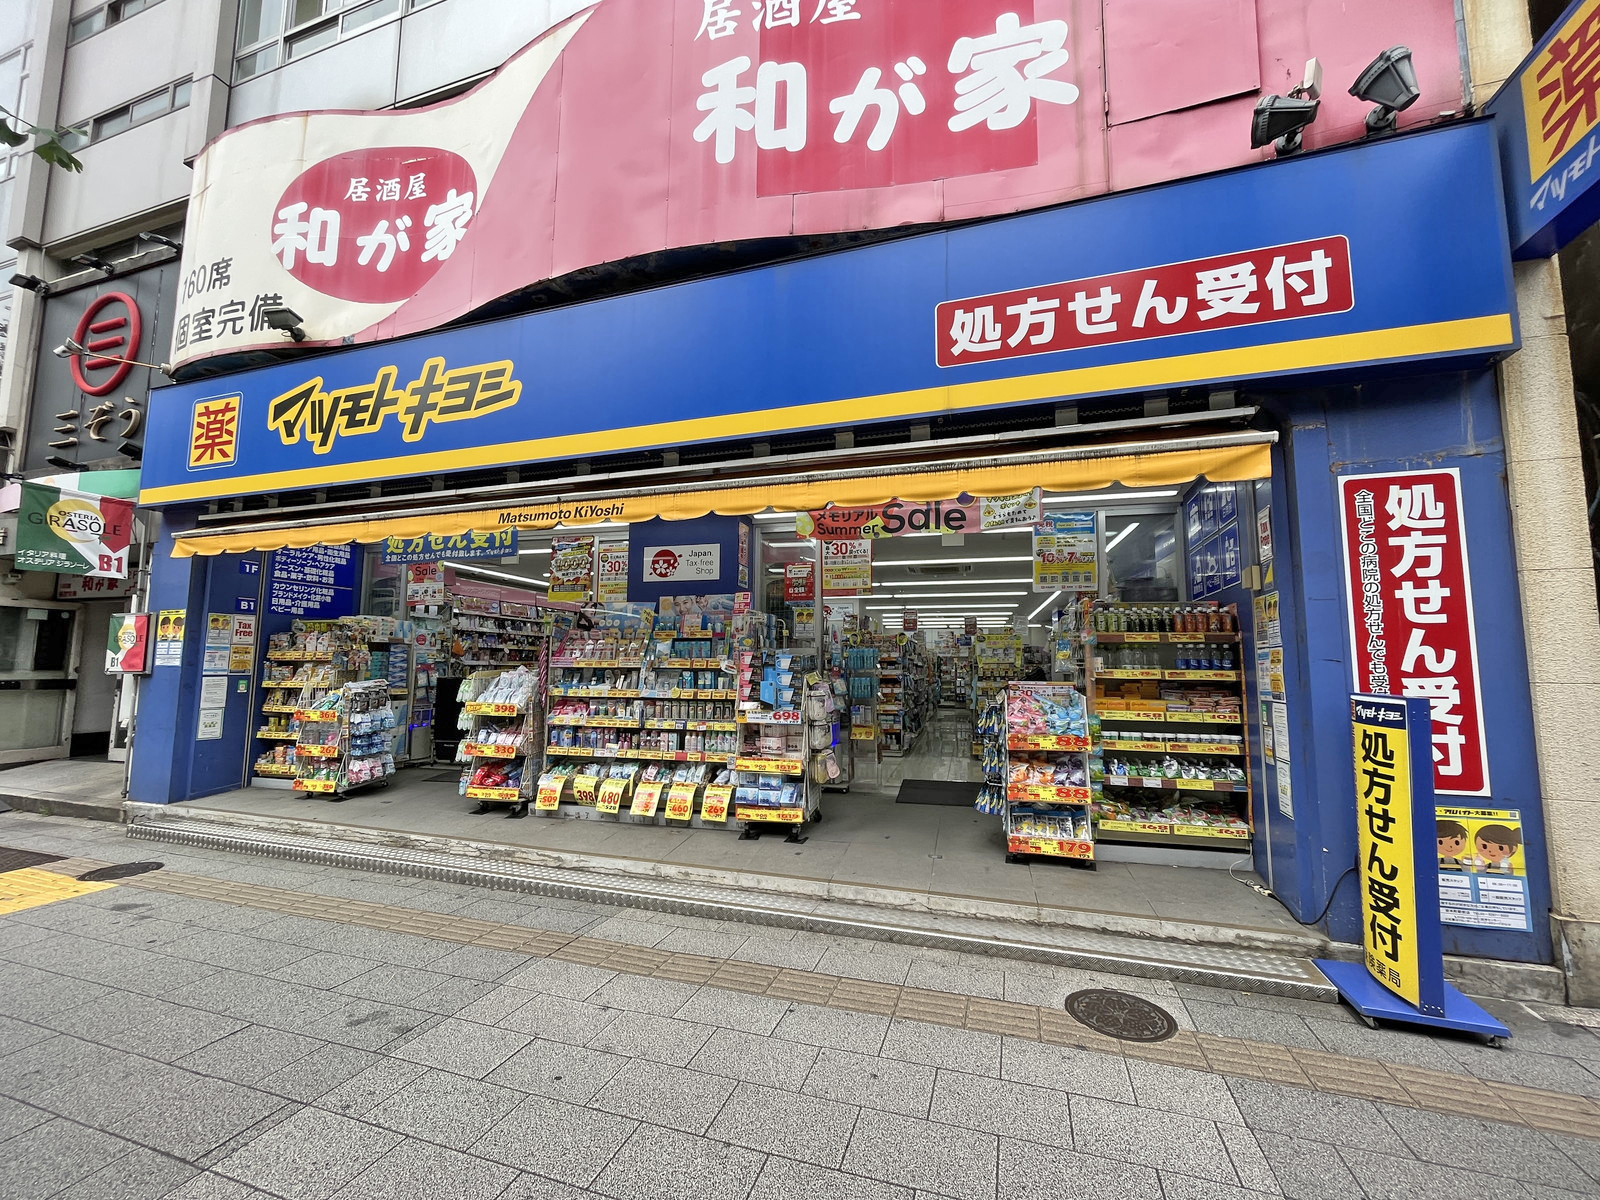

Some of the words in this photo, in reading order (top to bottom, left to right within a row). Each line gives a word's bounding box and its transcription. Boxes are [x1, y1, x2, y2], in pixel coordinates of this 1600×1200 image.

[694, 0, 861, 41] 居酒屋
[692, 12, 1080, 164] 和が家
[344, 172, 428, 203] 居酒屋
[271, 189, 476, 272] 和が家
[182, 257, 233, 304] 160席
[949, 248, 1333, 357] 処方せん受付
[271, 359, 520, 451] マツモトキヨシ
[47, 396, 142, 449] 三ぞう
[193, 405, 236, 464] 薬
[58, 510, 100, 521] OSTERIA
[498, 508, 571, 525] Matsumoto
[573, 502, 625, 518] KiYoshi
[816, 509, 878, 522] メモリアル
[817, 523, 879, 536] Summer
[880, 500, 967, 533] Sale
[27, 512, 122, 537] GIRASOLE
[17, 549, 67, 561] イタリア料理
[17, 557, 55, 567] オステリア
[98, 554, 123, 573] B1
[686, 559, 714, 567] Tax-free
[244, 564, 259, 574] 1F
[415, 566, 437, 576] Sale
[695, 567, 714, 576] Shop
[240, 601, 255, 610] B1
[237, 621, 252, 629] Tax
[1385, 484, 1466, 776] 処方せん受付
[235, 629, 253, 637] Free
[110, 657, 119, 667] B1
[494, 704, 516, 713] 398
[773, 711, 800, 720] 698
[319, 746, 337, 755] 267
[494, 746, 515, 754] 330
[576, 789, 595, 802] 398
[601, 791, 620, 805] 480
[1056, 787, 1090, 799] 88
[541, 795, 558, 804] 509
[671, 804, 689, 813] 460
[708, 804, 725, 814] 269
[1057, 841, 1092, 854] 179
[1360, 728, 1403, 962] 処方せん受付
